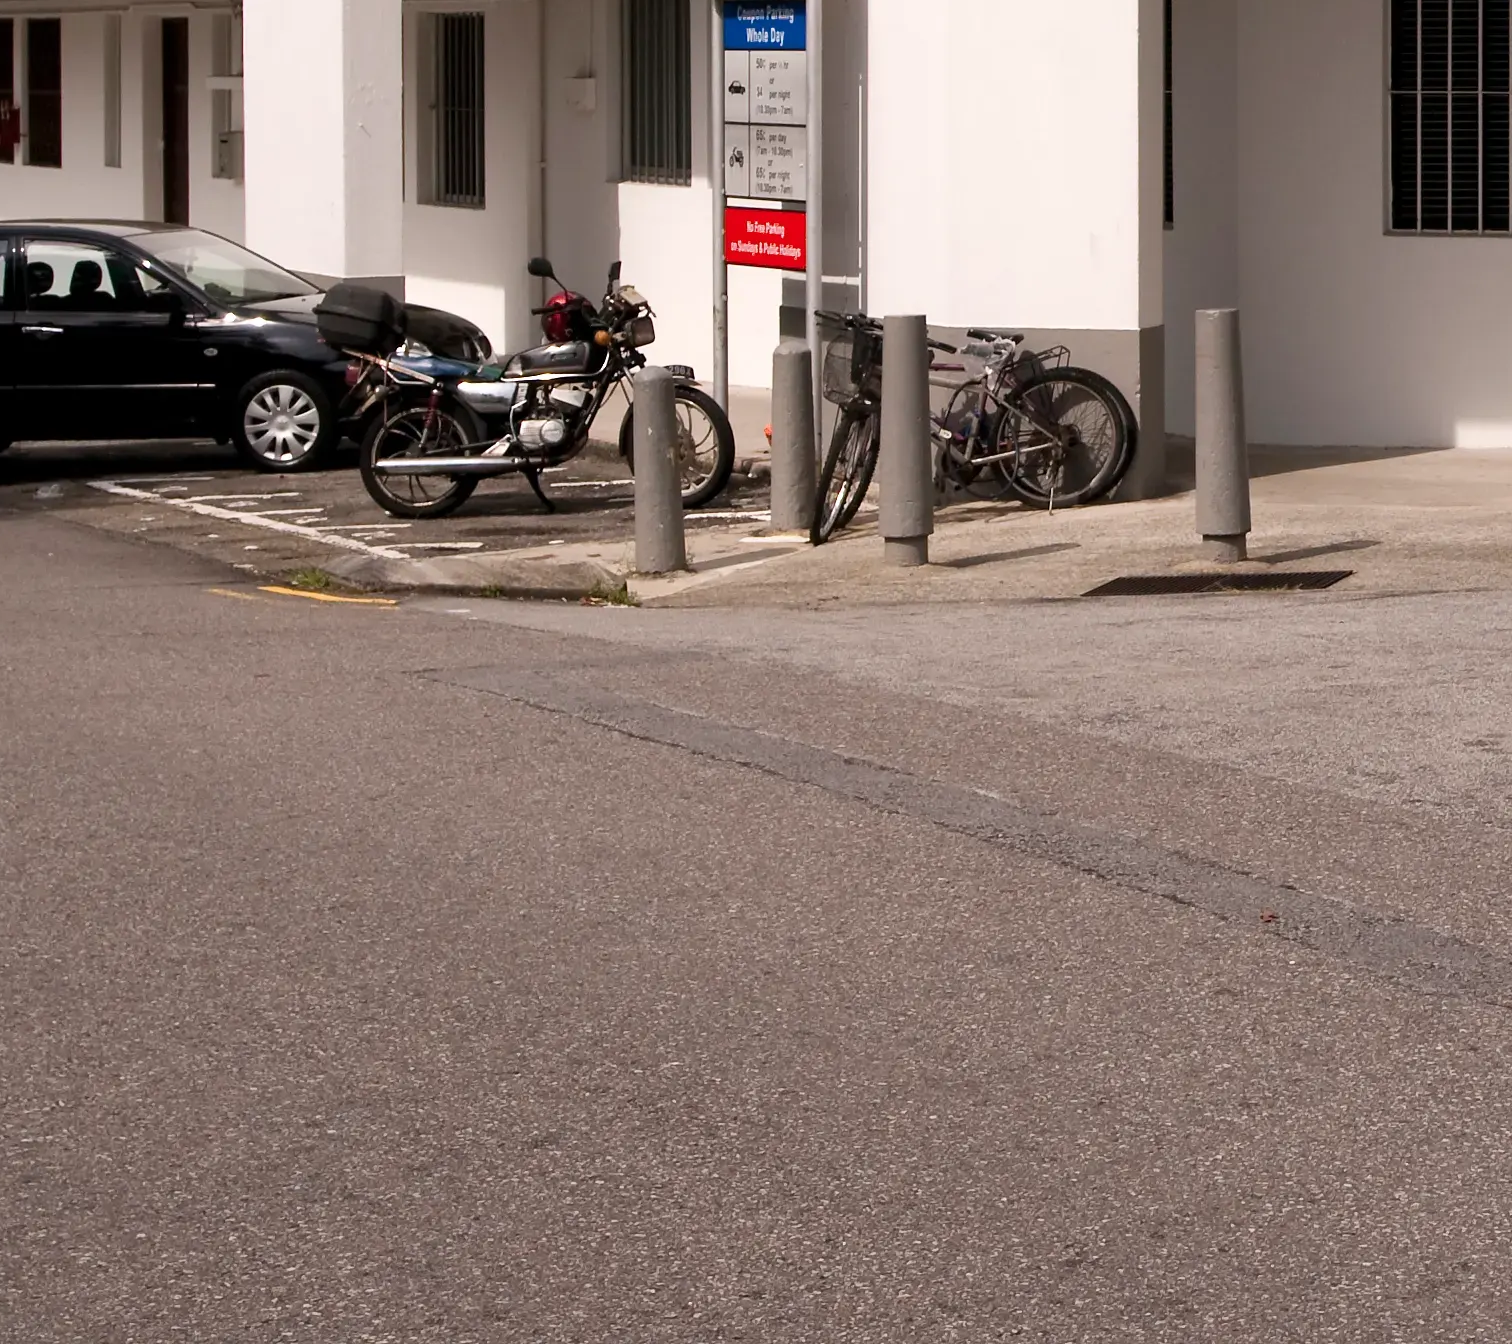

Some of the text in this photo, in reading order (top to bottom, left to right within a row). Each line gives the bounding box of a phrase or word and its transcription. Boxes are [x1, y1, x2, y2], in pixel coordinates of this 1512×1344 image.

[738, 5, 795, 24] Coupon Parking
[747, 28, 785, 46] Whole Day
[746, 221, 785, 238] No Free Parking
[738, 240, 759, 256] Sundays
[764, 243, 779, 255] Public
[780, 244, 802, 260] Holidays
